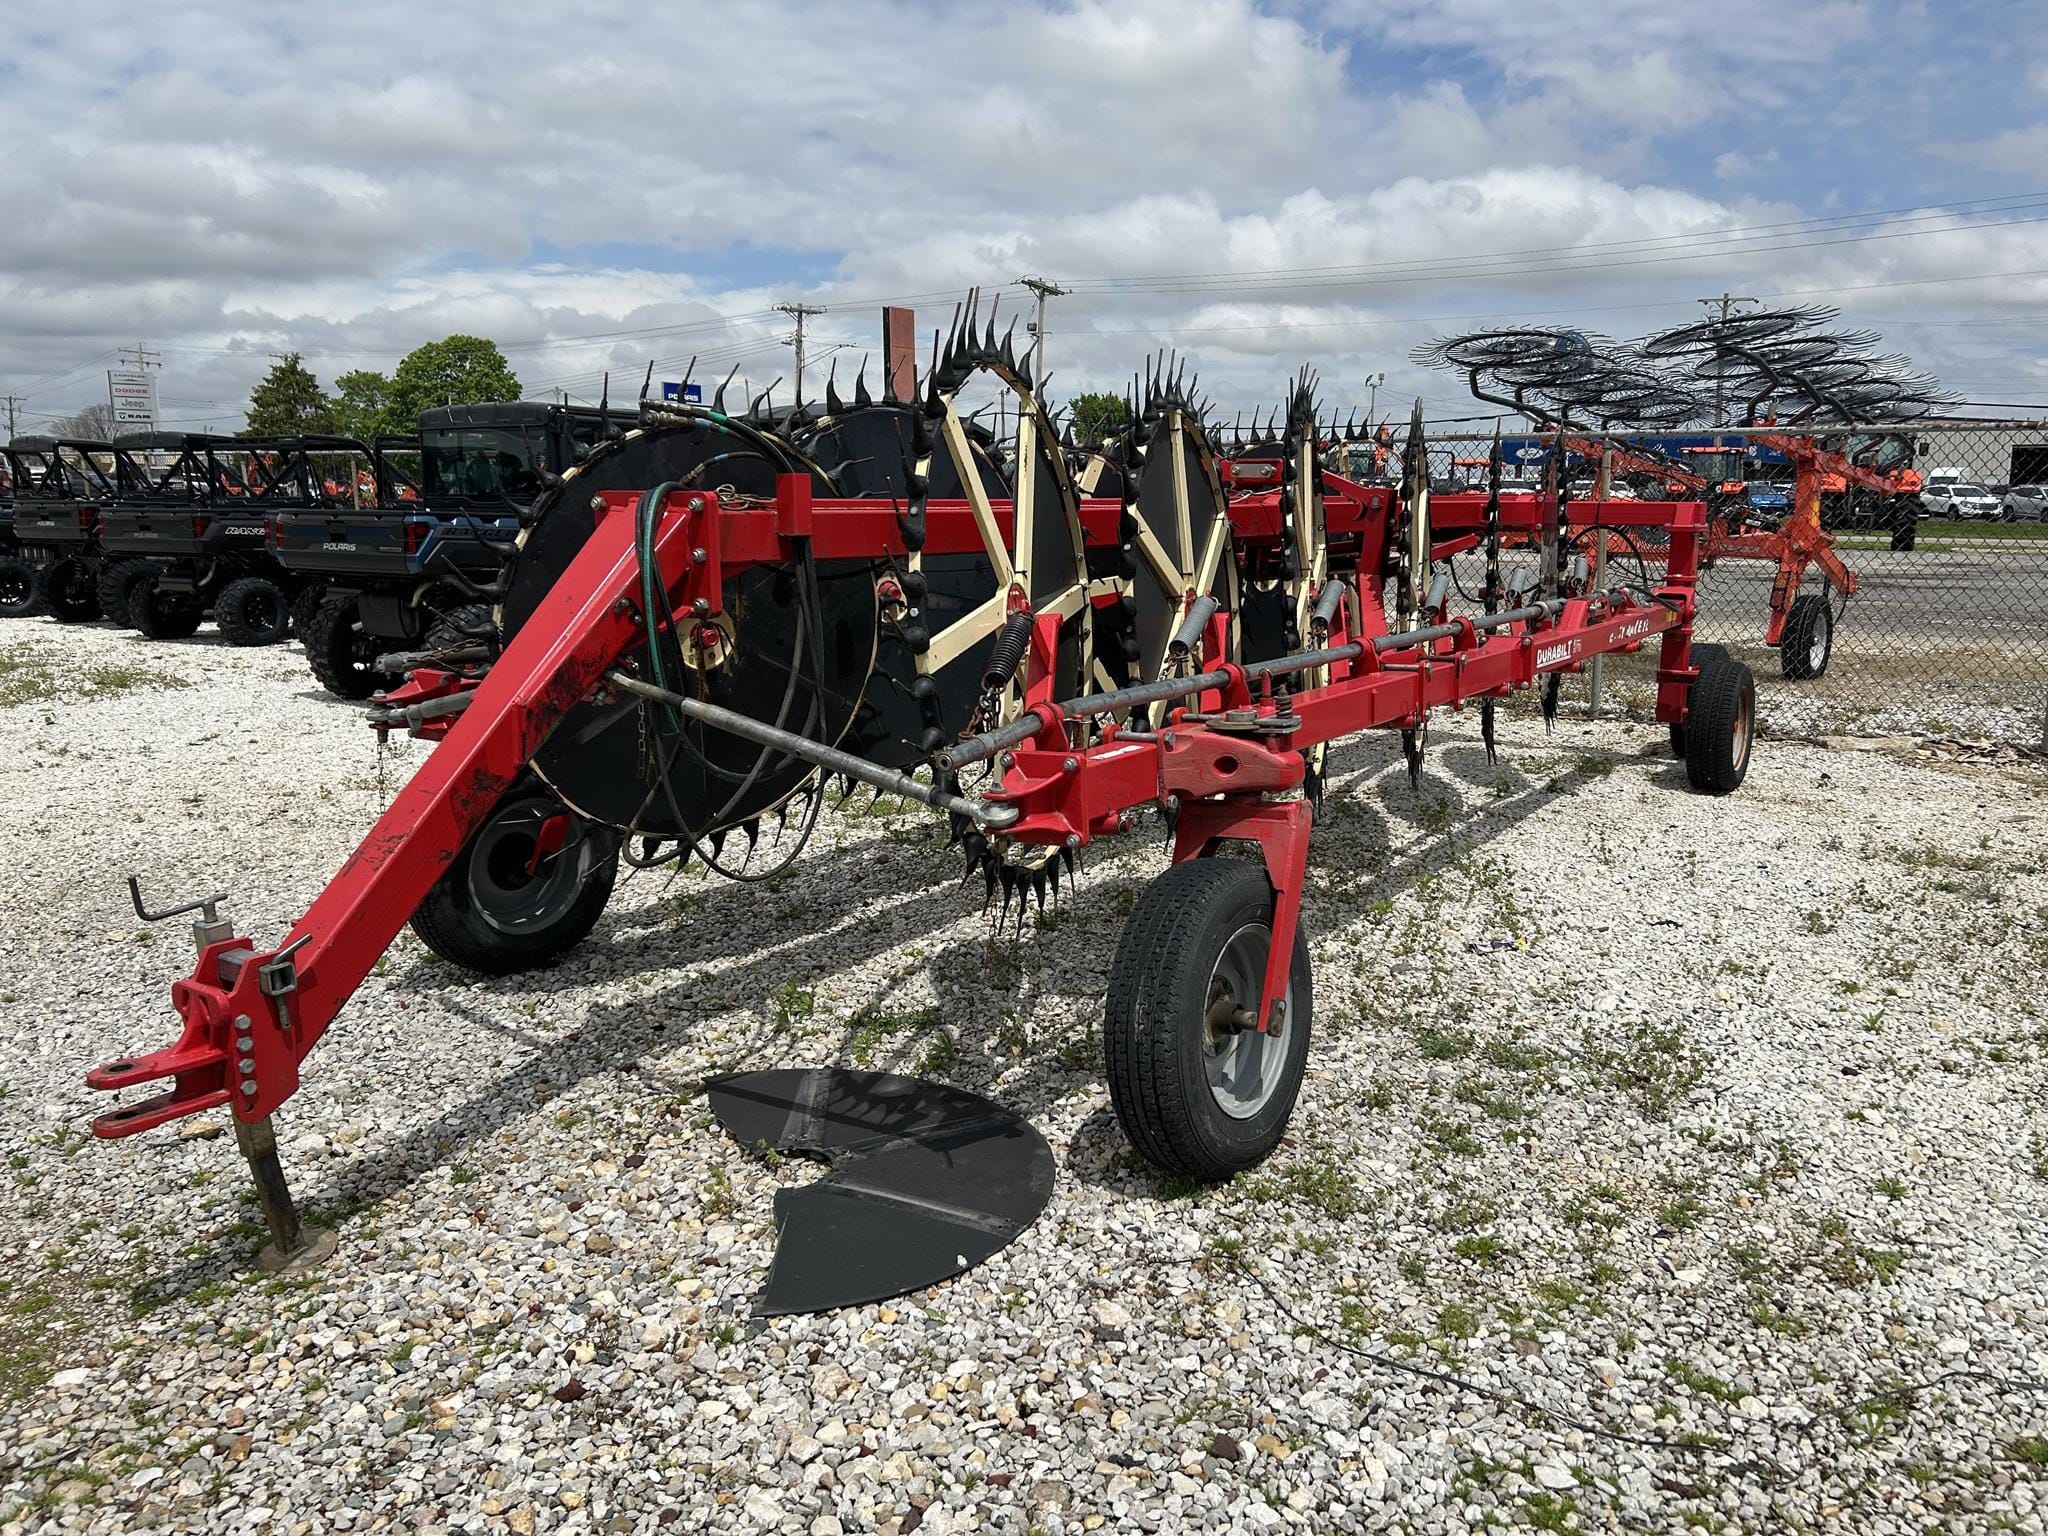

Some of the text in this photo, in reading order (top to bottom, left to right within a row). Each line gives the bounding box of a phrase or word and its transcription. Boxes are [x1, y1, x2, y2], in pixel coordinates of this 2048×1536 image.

[668, 393, 699, 401] POARIS
[121, 398, 145, 408] Jeep
[224, 526, 266, 536] RANG
[323, 542, 356, 551] POLARIS
[1537, 640, 1572, 664] DURABILT
